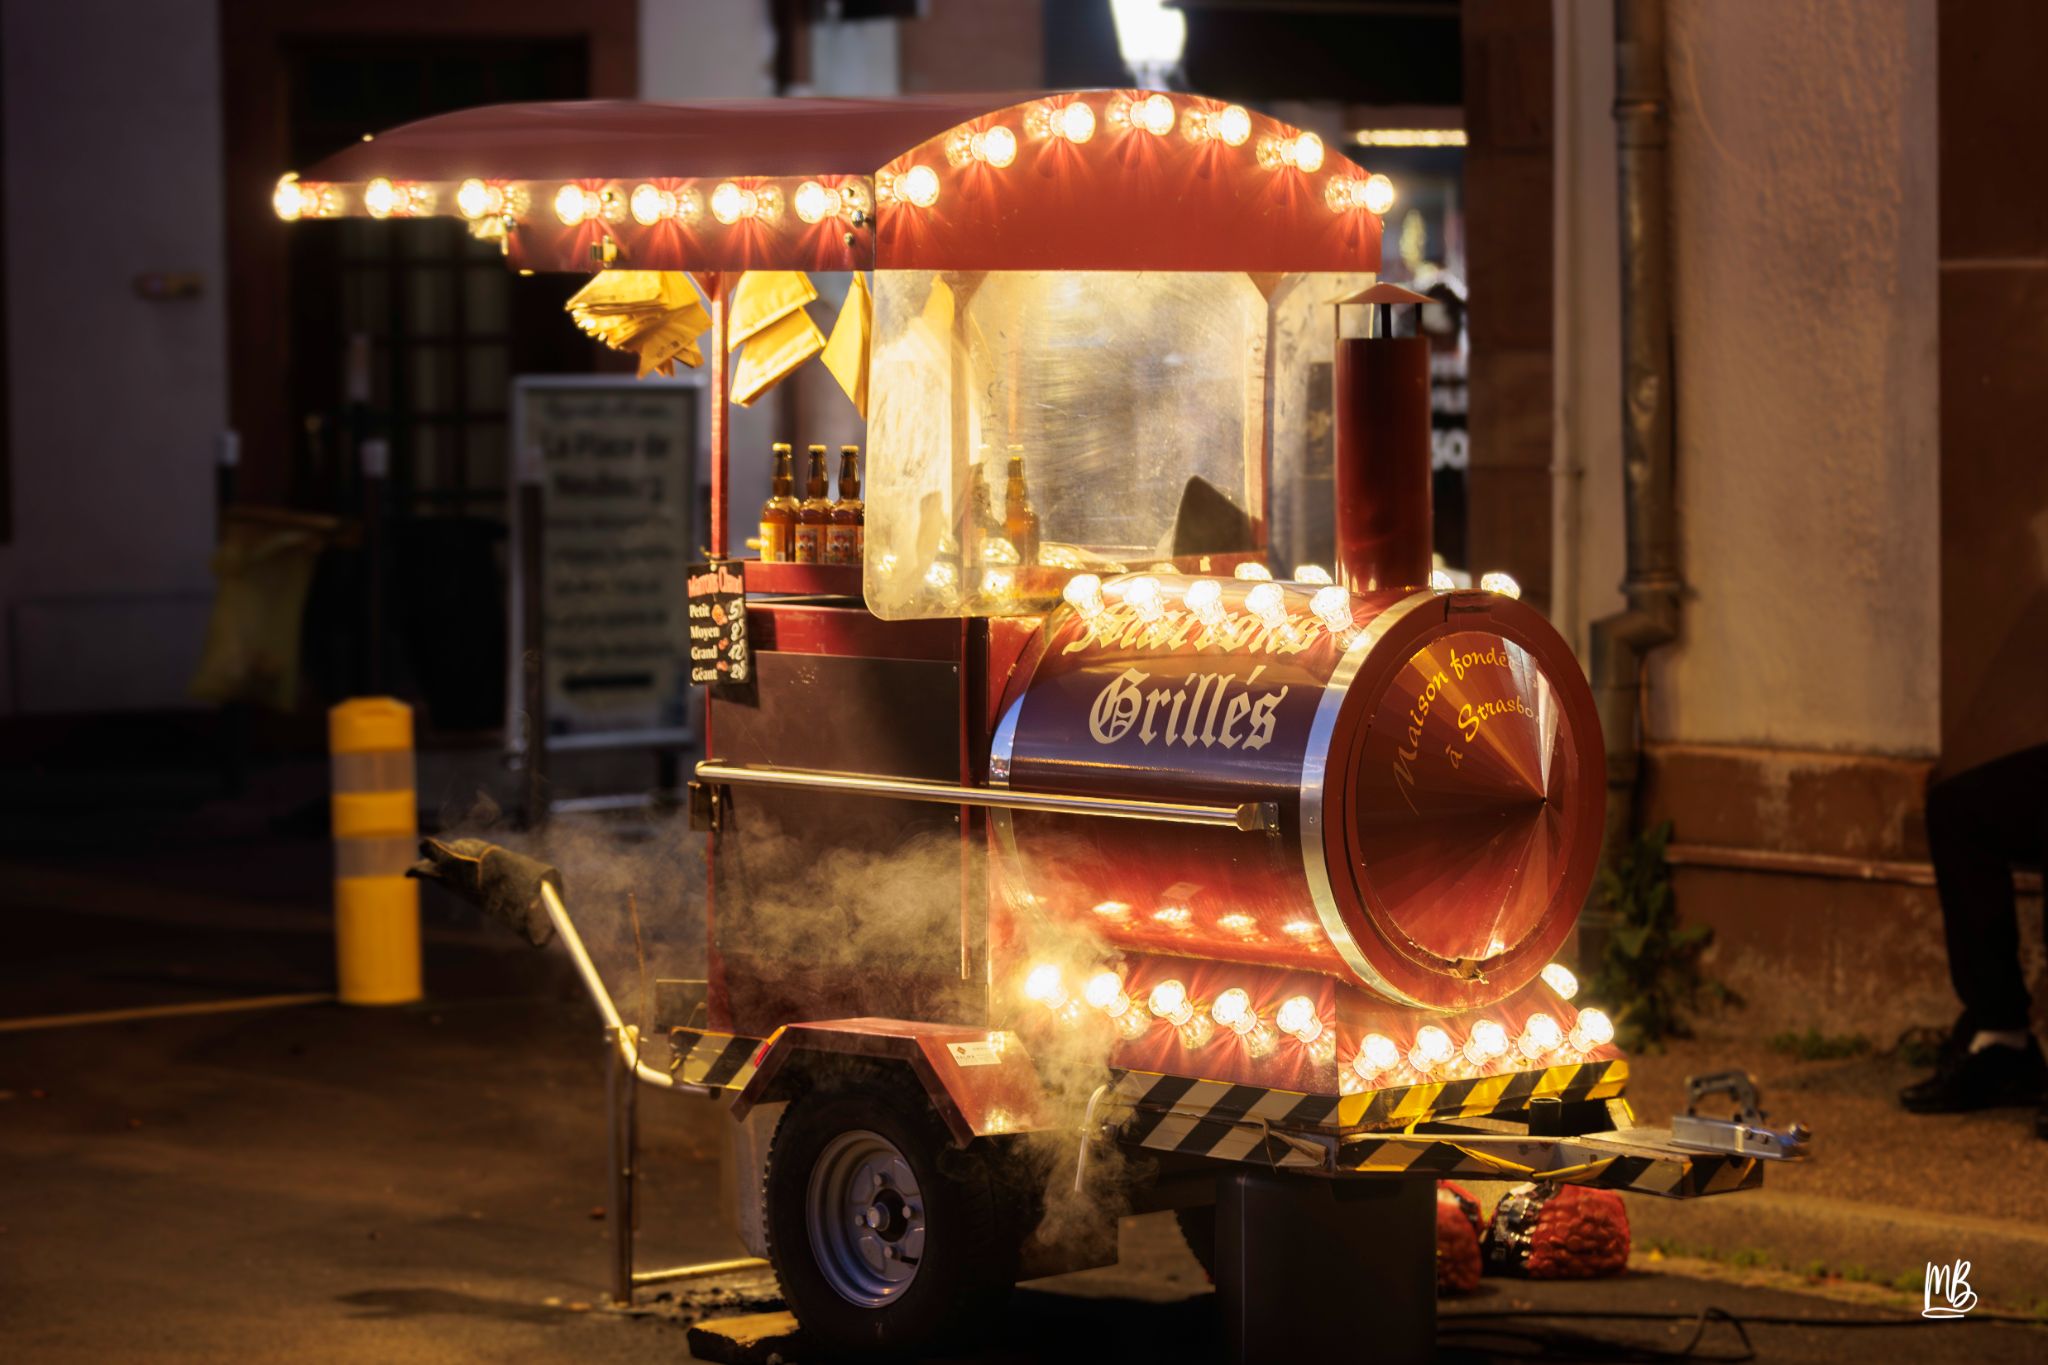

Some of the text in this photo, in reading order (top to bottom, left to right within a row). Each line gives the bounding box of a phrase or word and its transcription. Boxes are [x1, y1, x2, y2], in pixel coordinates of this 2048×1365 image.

[689, 603, 711, 618] Petit
[690, 625, 721, 641] Moyen
[691, 645, 719, 661] Grand
[692, 667, 719, 682] Géant
[1088, 665, 1289, 751] Grillés
[1445, 695, 1540, 769] à Strasbo
[1393, 671, 1449, 816] Maison
